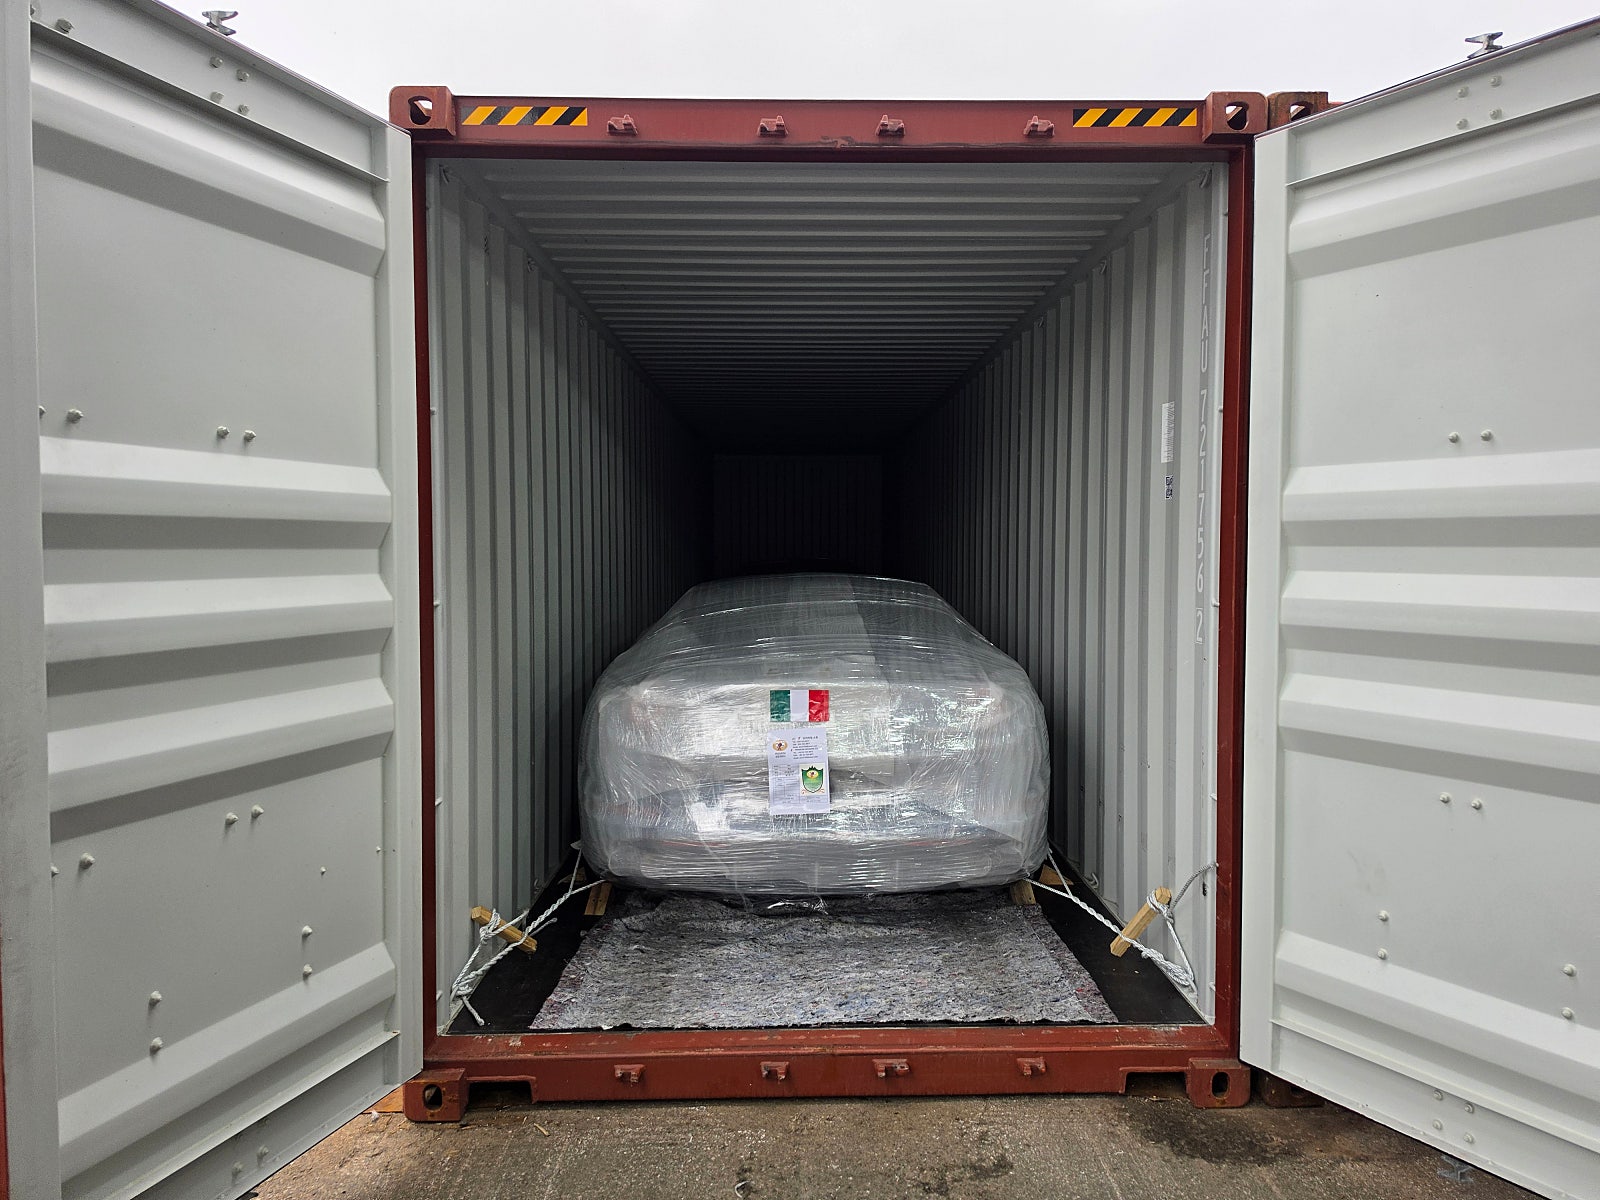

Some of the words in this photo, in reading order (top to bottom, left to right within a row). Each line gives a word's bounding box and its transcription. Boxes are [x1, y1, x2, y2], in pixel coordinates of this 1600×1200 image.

[1201, 233, 1211, 374] FFAU
[1196, 388, 1207, 593] 721756
[1196, 609, 1204, 644] 2
